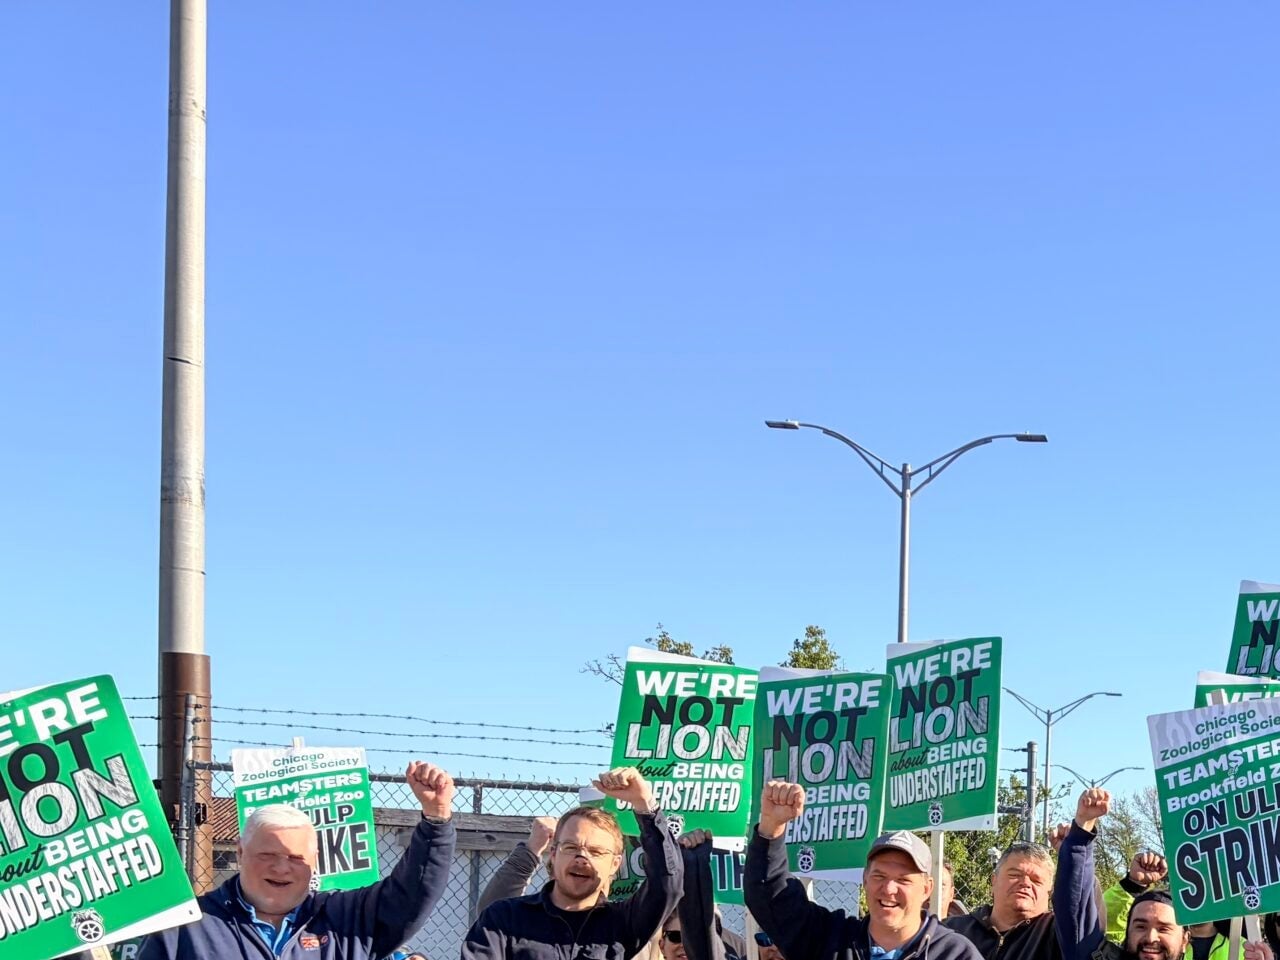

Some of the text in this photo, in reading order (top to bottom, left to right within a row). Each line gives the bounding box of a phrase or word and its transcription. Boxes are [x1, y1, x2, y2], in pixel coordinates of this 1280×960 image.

[894, 641, 992, 690] WE'RE
[635, 670, 758, 699] WE'RE
[766, 679, 882, 717] WE'RE
[899, 668, 982, 718] NOT
[0, 682, 108, 757] E'RE
[640, 694, 744, 728] NOT
[772, 705, 869, 751] NOT
[889, 694, 990, 754] LION
[1195, 709, 1256, 735] Chicago
[0, 721, 95, 797] OT
[272, 752, 325, 767] Chicago
[624, 723, 750, 760] LION
[889, 737, 988, 774] about BEING
[1159, 728, 1237, 762] Zoological
[242, 757, 359, 782] Zoological Society
[635, 758, 745, 779] bout BEING
[762, 737, 876, 790] LION
[242, 772, 363, 803] TEAMSTERS
[616, 780, 741, 813] ERSTAFFED
[805, 782, 871, 805] BEING
[889, 760, 986, 809] UNDERSTAFFED
[1166, 764, 1264, 813] Brookfield
[0, 753, 140, 857] ION
[244, 791, 365, 817] Bkfield Zoo
[1183, 804, 1228, 837] ON
[785, 803, 868, 844] ERSTAFFED
[0, 809, 149, 883] out BEING
[316, 821, 372, 876] IKE
